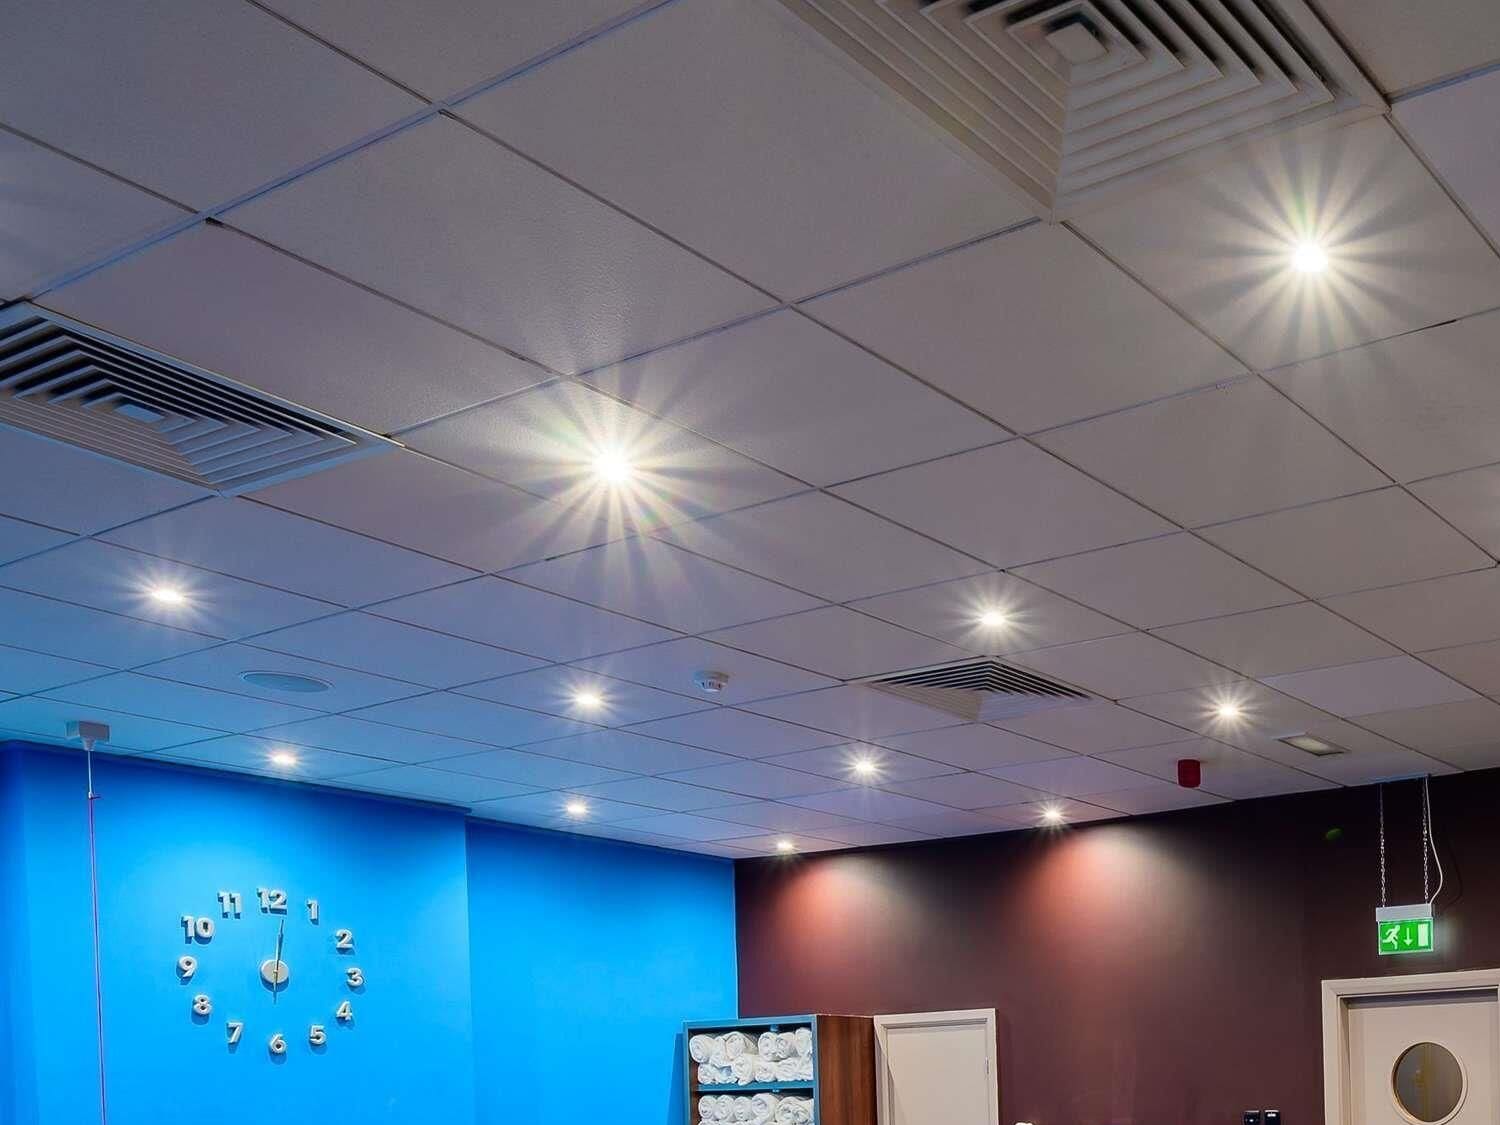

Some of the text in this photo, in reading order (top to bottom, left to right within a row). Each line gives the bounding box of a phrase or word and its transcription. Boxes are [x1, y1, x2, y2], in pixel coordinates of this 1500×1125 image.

[218, 891, 242, 914] 11
[257, 888, 287, 911] 12
[307, 899, 319, 920] 1
[182, 916, 215, 938] 10
[335, 929, 353, 949] 2
[178, 955, 198, 978] 9
[346, 968, 364, 987] 3
[193, 995, 213, 1015] 8
[335, 1001, 353, 1021] 4
[227, 1022, 244, 1044] 7
[269, 1033, 287, 1054] 6
[309, 1025, 327, 1045] 5
